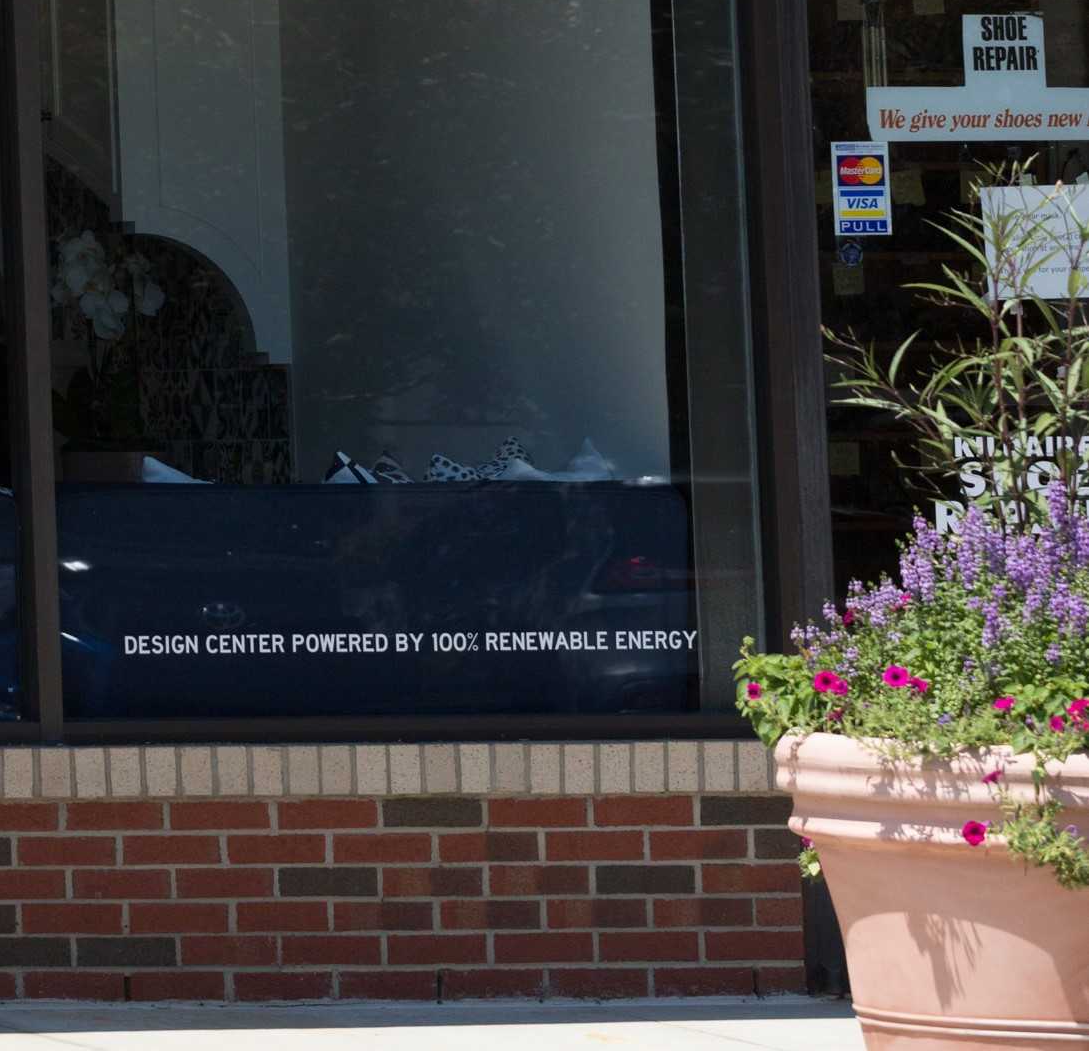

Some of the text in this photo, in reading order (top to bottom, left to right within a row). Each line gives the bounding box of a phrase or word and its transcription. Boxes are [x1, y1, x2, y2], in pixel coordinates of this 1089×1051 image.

[981, 16, 1028, 41] SHOE
[973, 46, 1038, 71] REPAIR
[879, 109, 905, 128] We
[911, 109, 945, 132] give
[950, 113, 991, 132] your
[994, 109, 1042, 128] shoes
[1047, 113, 1082, 128] new
[847, 198, 879, 209] VISA
[841, 221, 888, 232] PULL
[124, 630, 698, 655] DESIGN CENTER POWERED BY 100% RENEWABLE ENERGY
